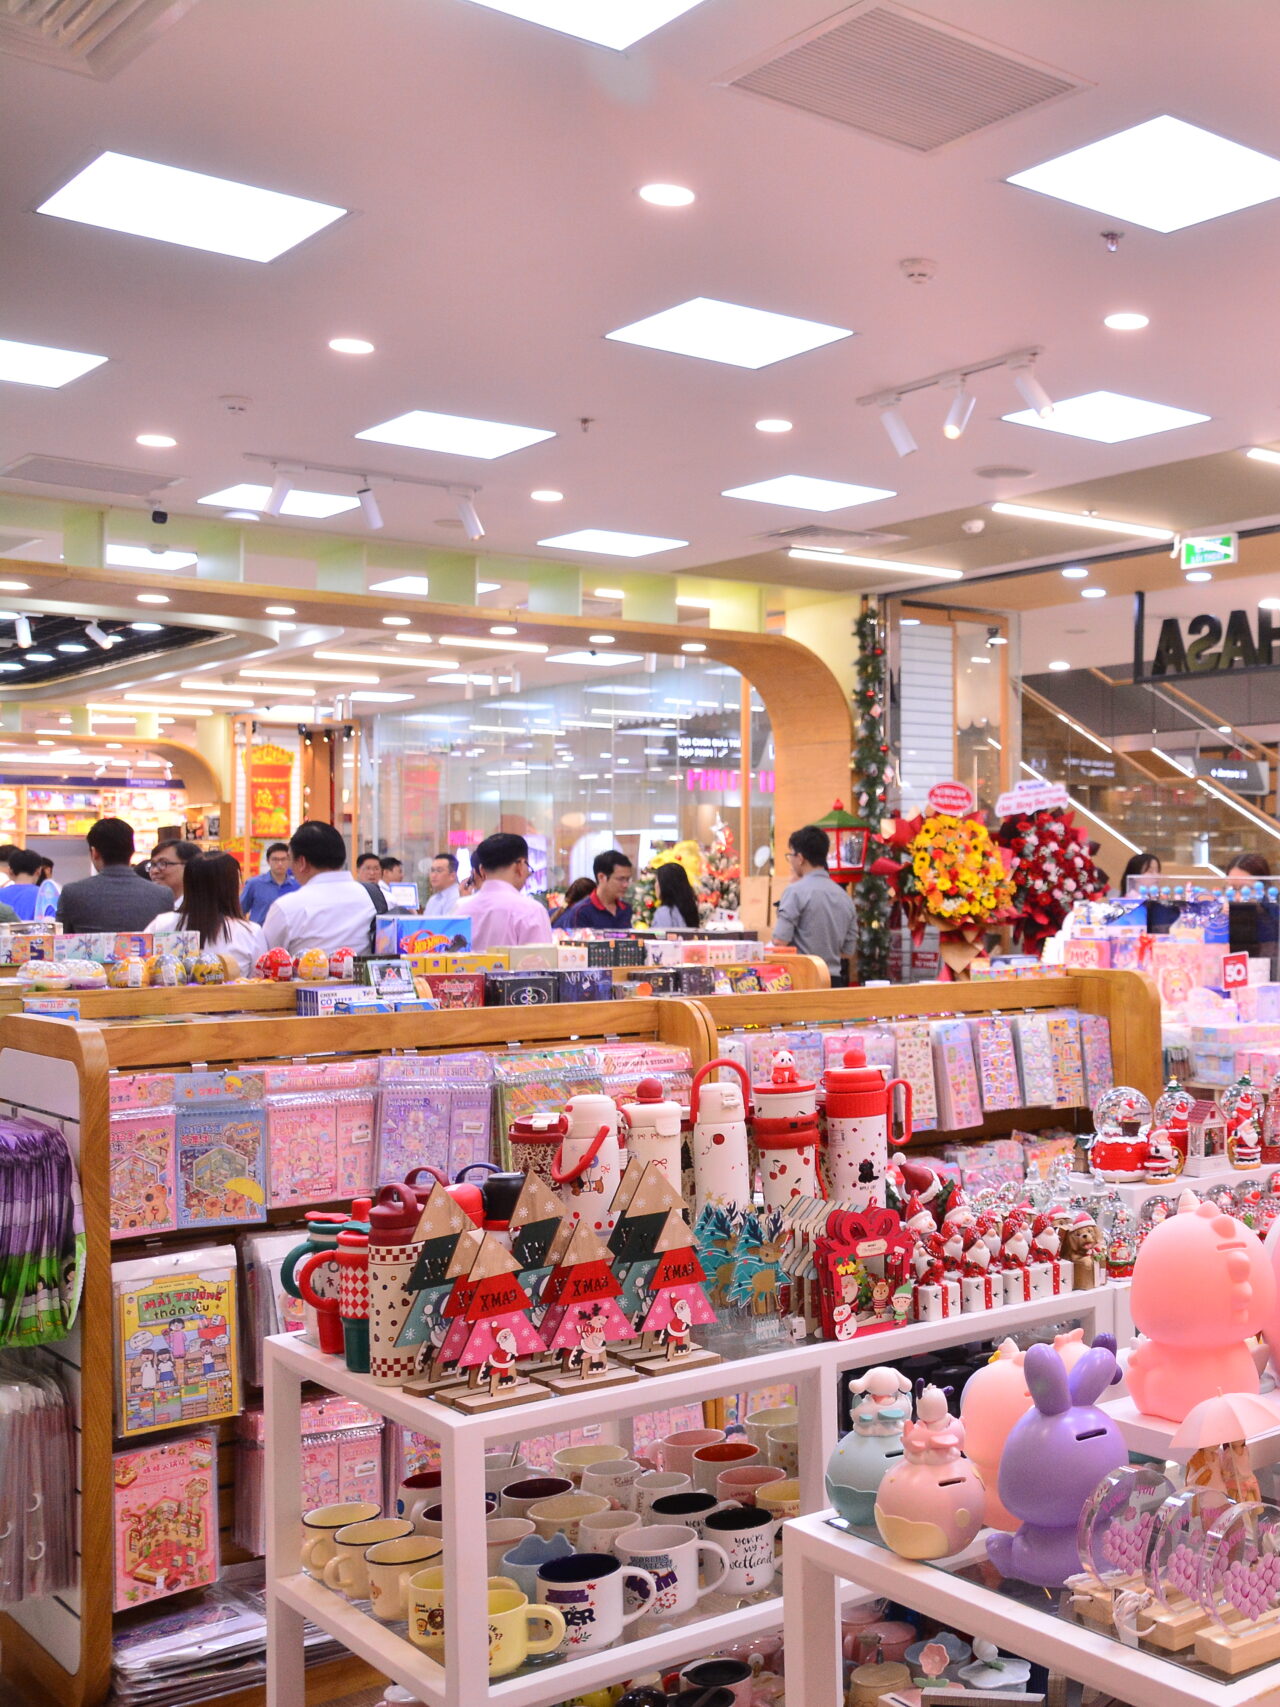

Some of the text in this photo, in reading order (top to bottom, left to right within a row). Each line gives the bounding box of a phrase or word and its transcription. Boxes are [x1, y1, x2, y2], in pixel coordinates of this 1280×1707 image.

[766, 973, 793, 993] UNO
[1225, 963, 1246, 983] 50
[663, 1262, 695, 1281] XMAS
[572, 1275, 609, 1297] XMAS
[480, 1289, 518, 1312] XMAS
[154, 1304, 185, 1319] thân
